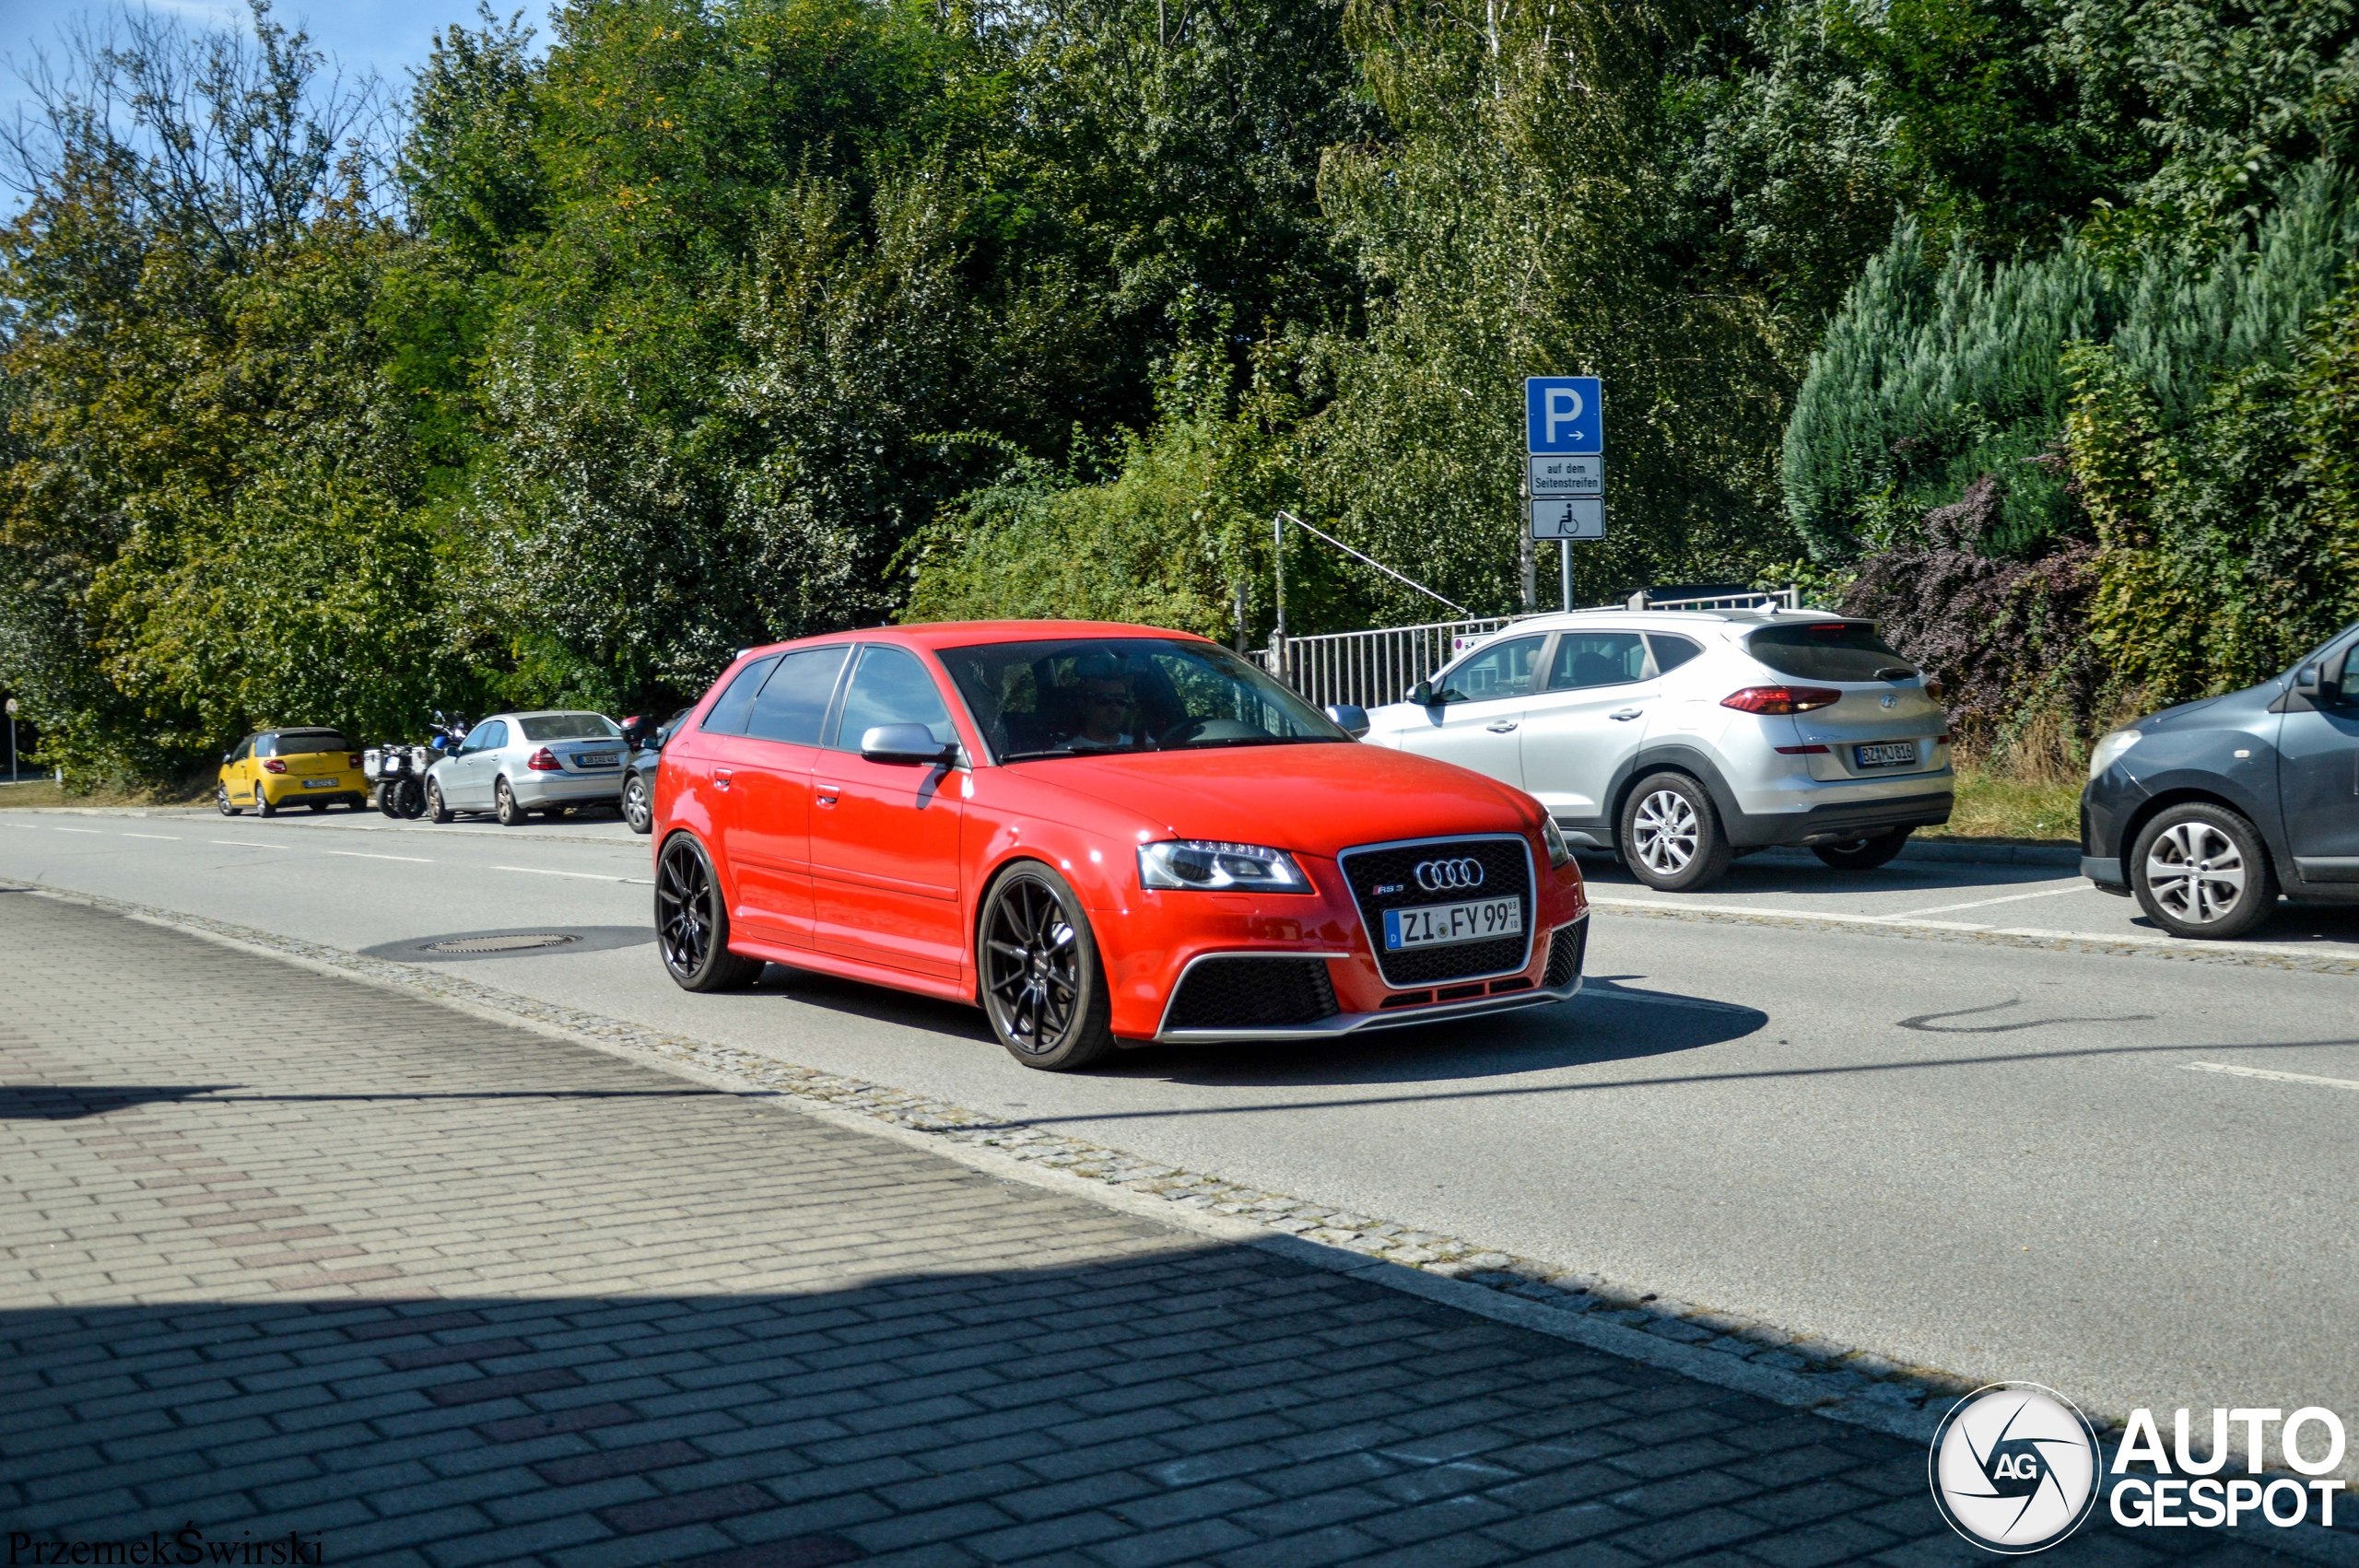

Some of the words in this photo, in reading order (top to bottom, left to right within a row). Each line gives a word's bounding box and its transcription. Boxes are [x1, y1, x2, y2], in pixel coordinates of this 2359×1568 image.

[1544, 387, 1583, 443] P
[1547, 462, 1562, 474] auf
[1567, 462, 1586, 474] dem
[1535, 477, 1598, 488] Seitenstreifen
[1862, 747, 1877, 762] BZ
[1895, 744, 1912, 759] 816
[1402, 911, 1435, 942] ZI
[1450, 906, 1478, 937] FY
[1485, 903, 1508, 932] 99
[1510, 920, 1519, 929] 10
[1391, 934, 1397, 942] D
